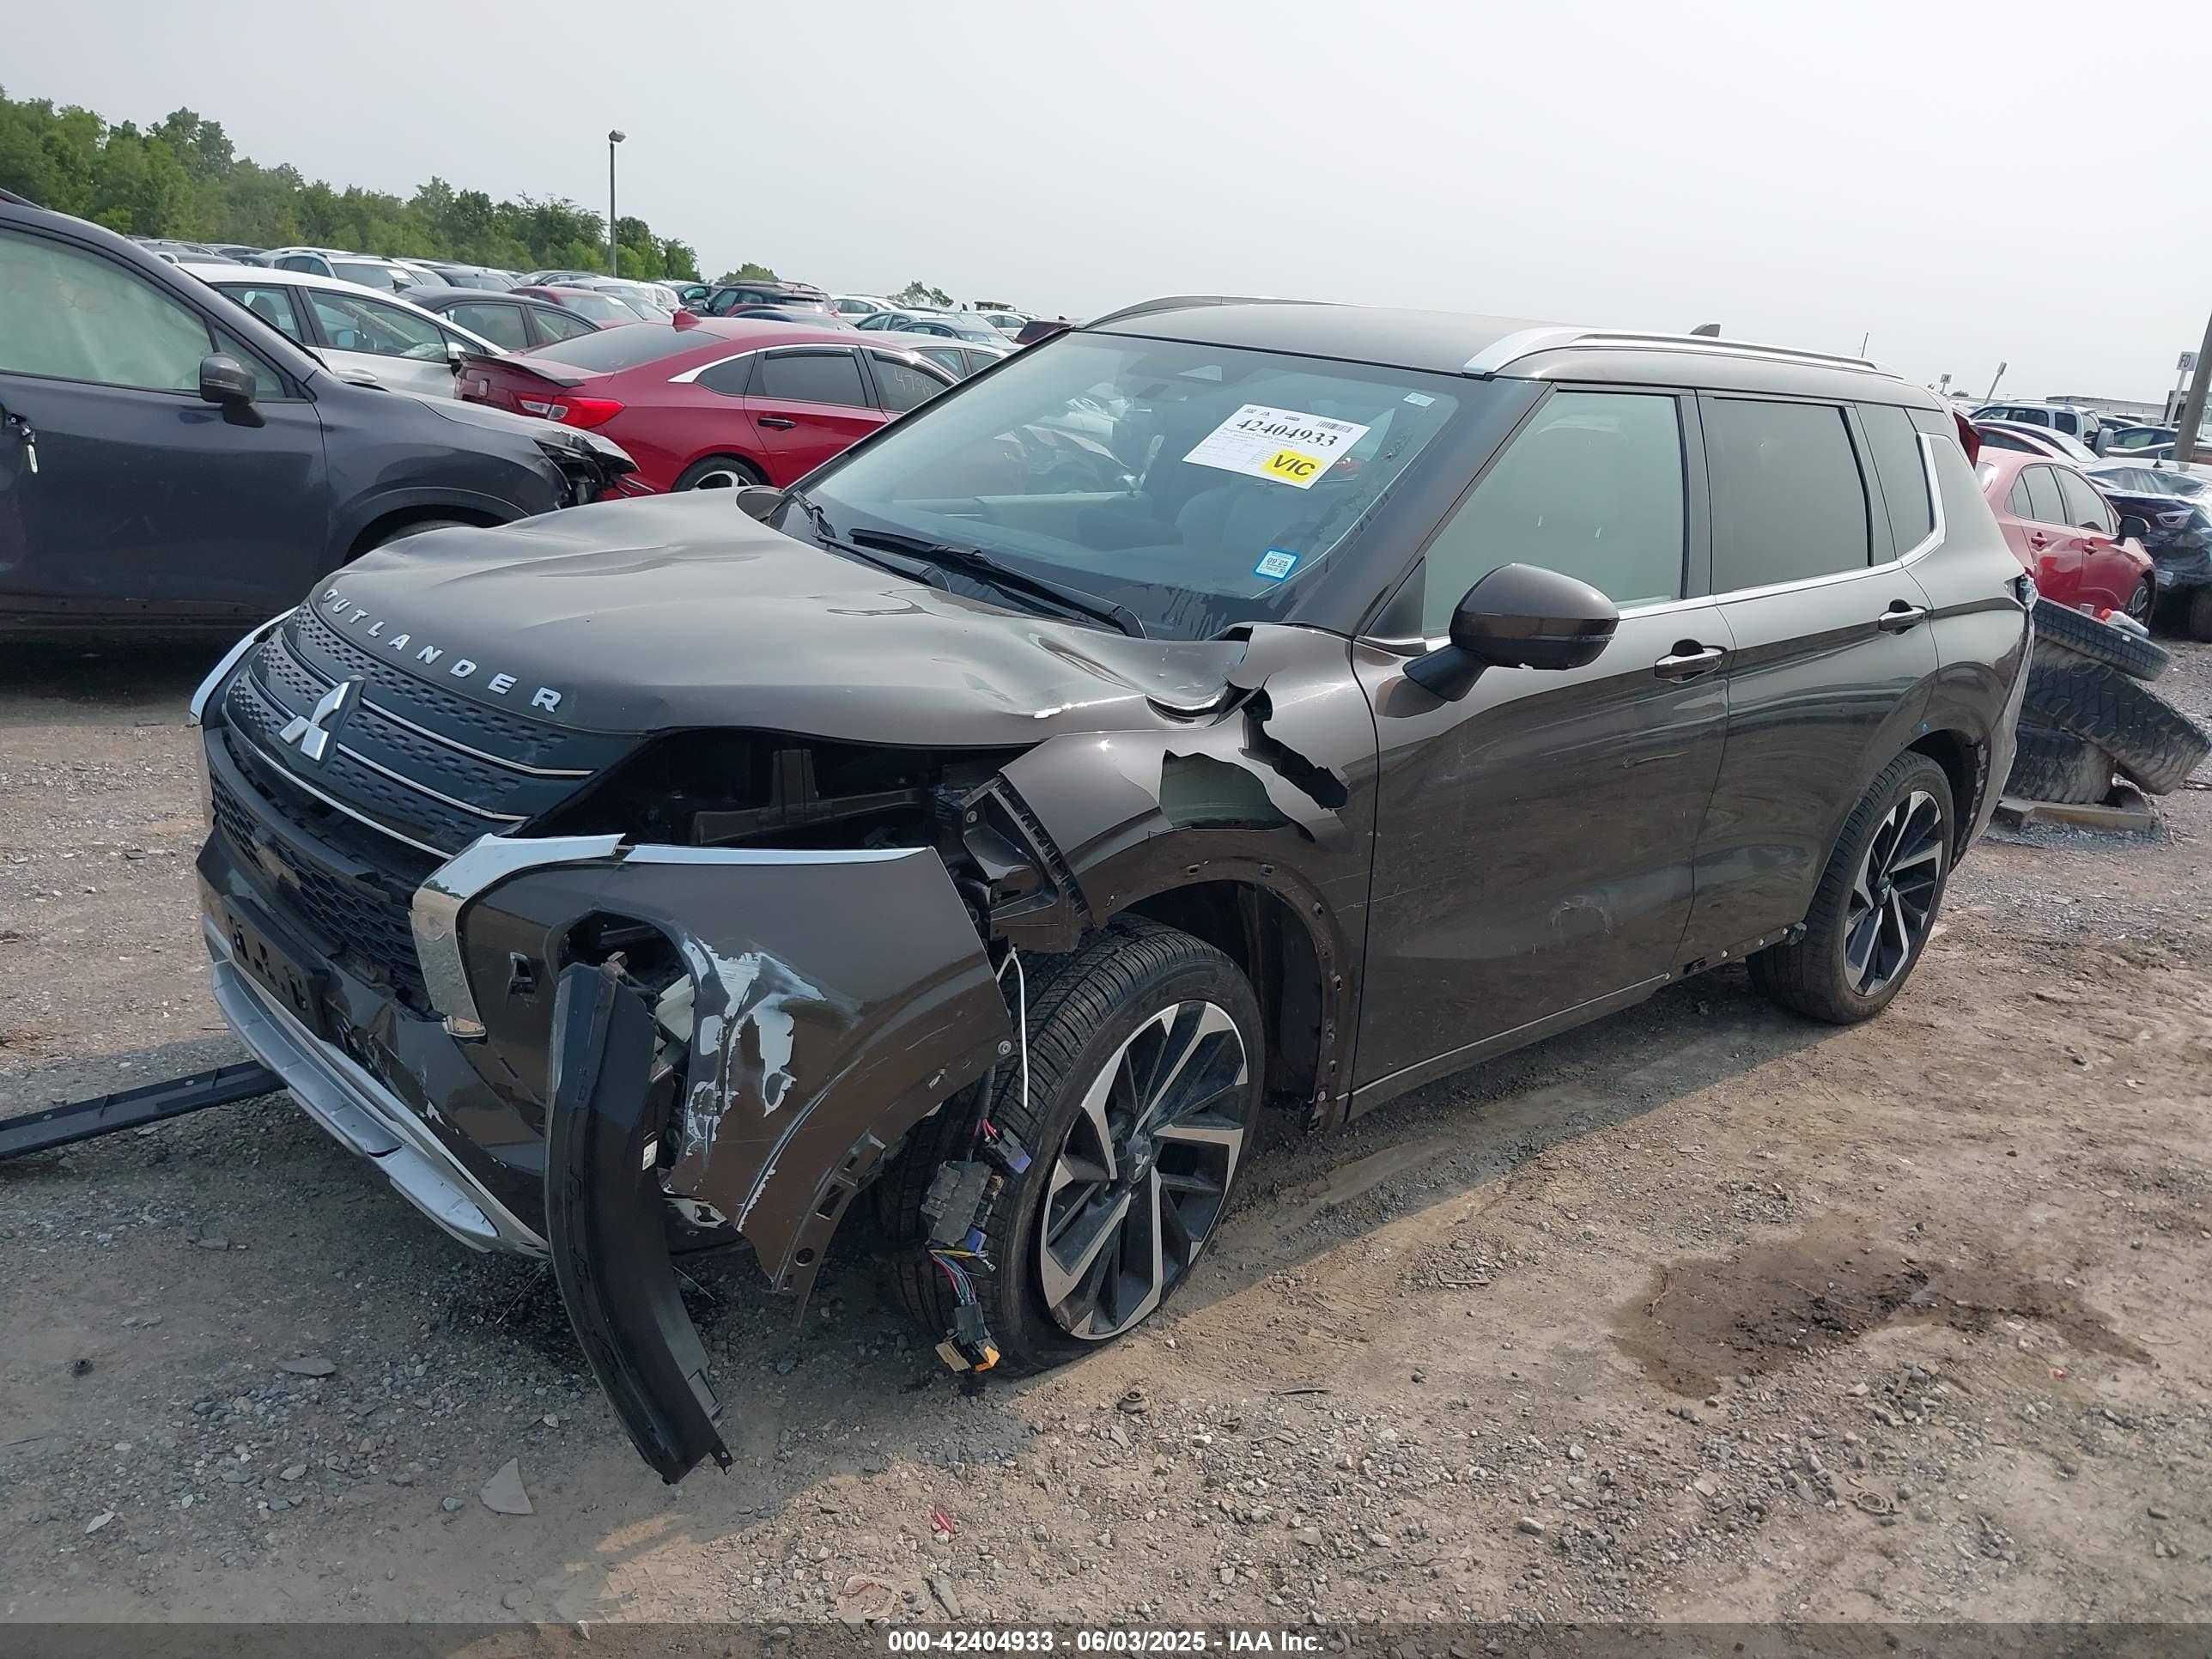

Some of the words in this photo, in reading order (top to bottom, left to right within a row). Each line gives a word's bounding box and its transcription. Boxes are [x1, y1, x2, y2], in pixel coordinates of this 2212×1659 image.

[1237, 419, 1339, 447] 42404933
[1273, 454, 1316, 476] VIC
[322, 588, 562, 713] OUTLANDER
